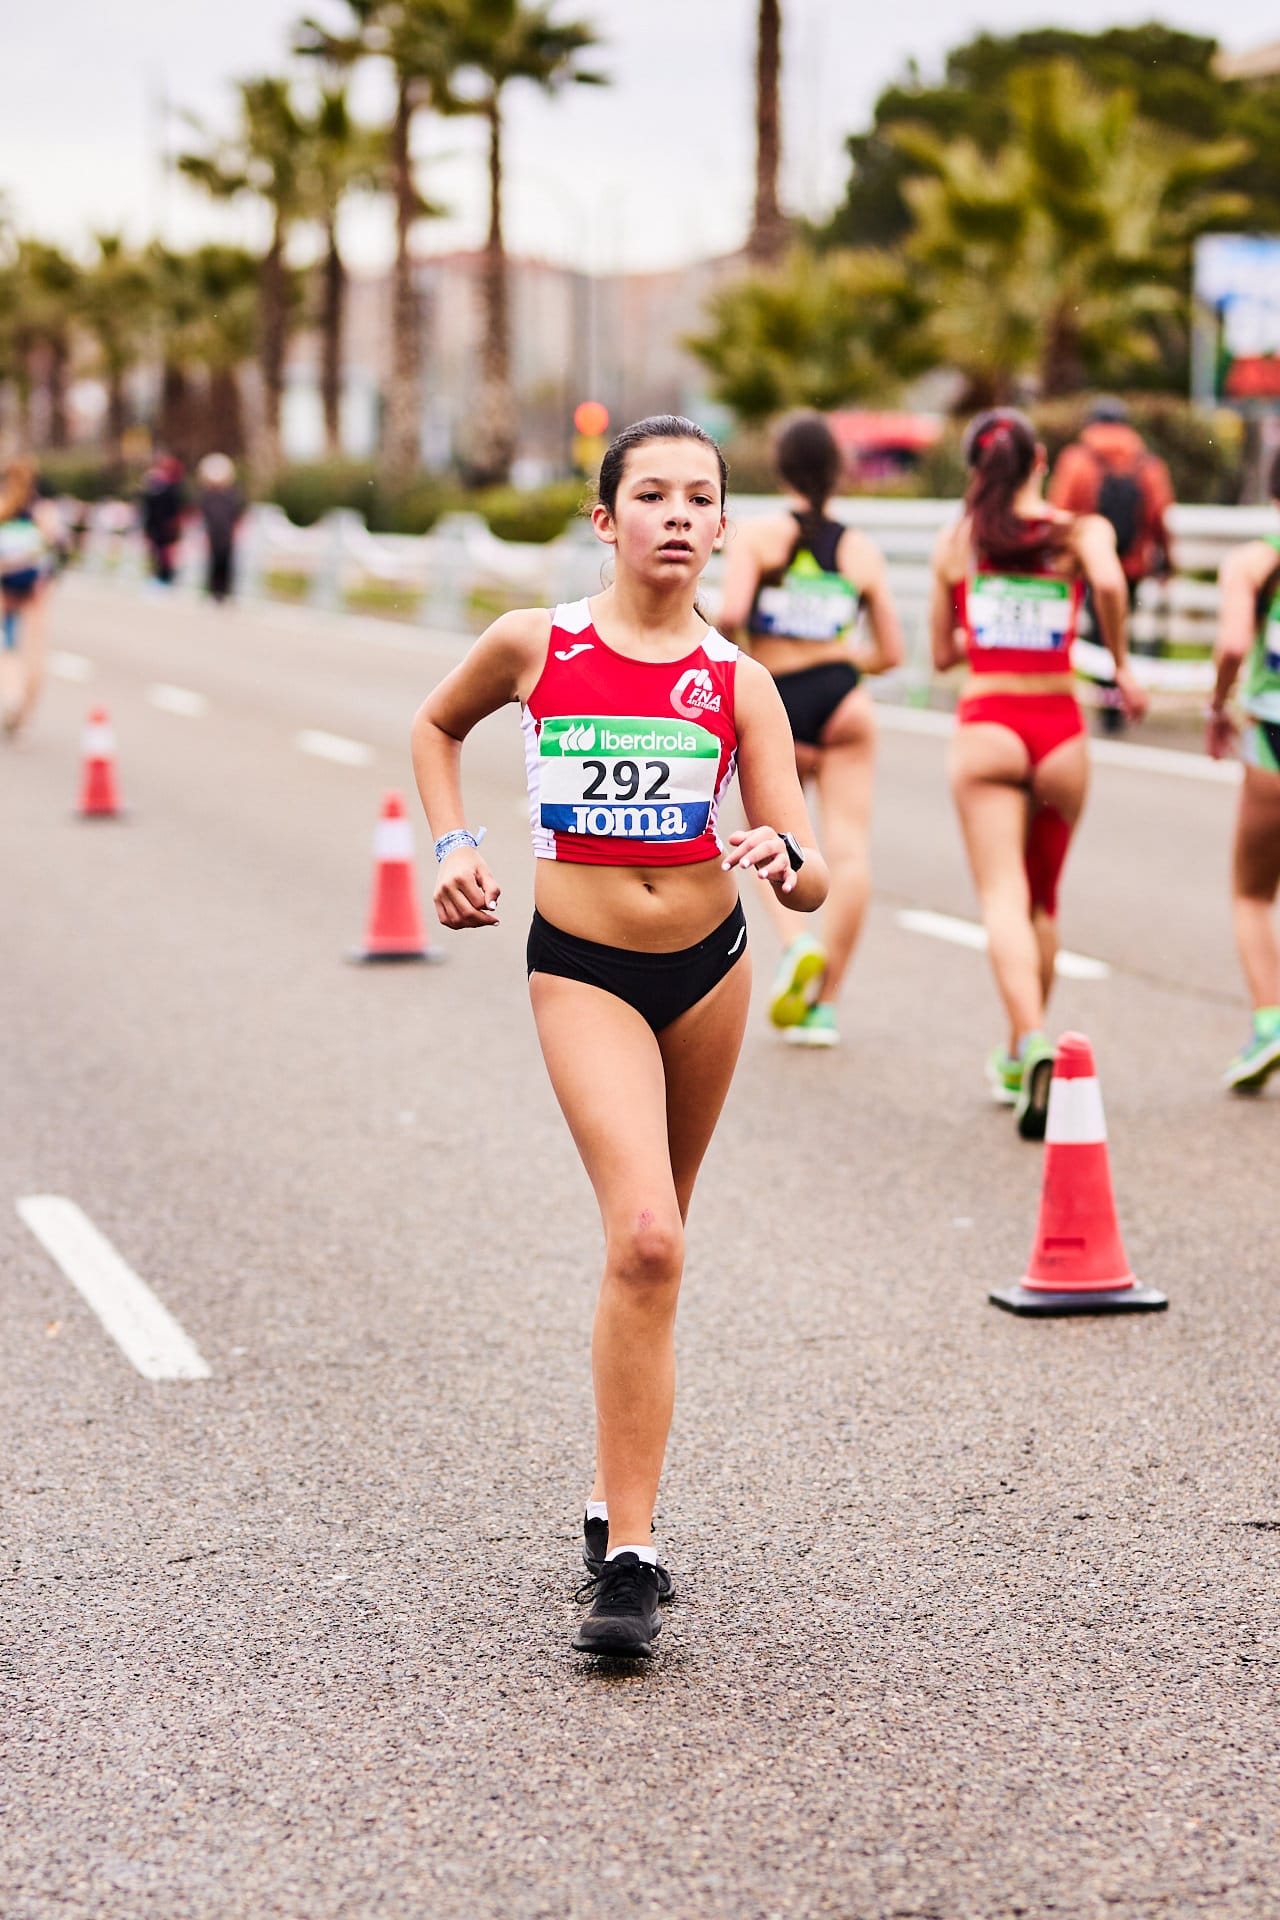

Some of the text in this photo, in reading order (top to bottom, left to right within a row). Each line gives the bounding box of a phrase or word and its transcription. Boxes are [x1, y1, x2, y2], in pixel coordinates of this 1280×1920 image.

[689, 687, 721, 708] FNA
[600, 729, 697, 751] Iberdrola
[582, 760, 671, 801] 292
